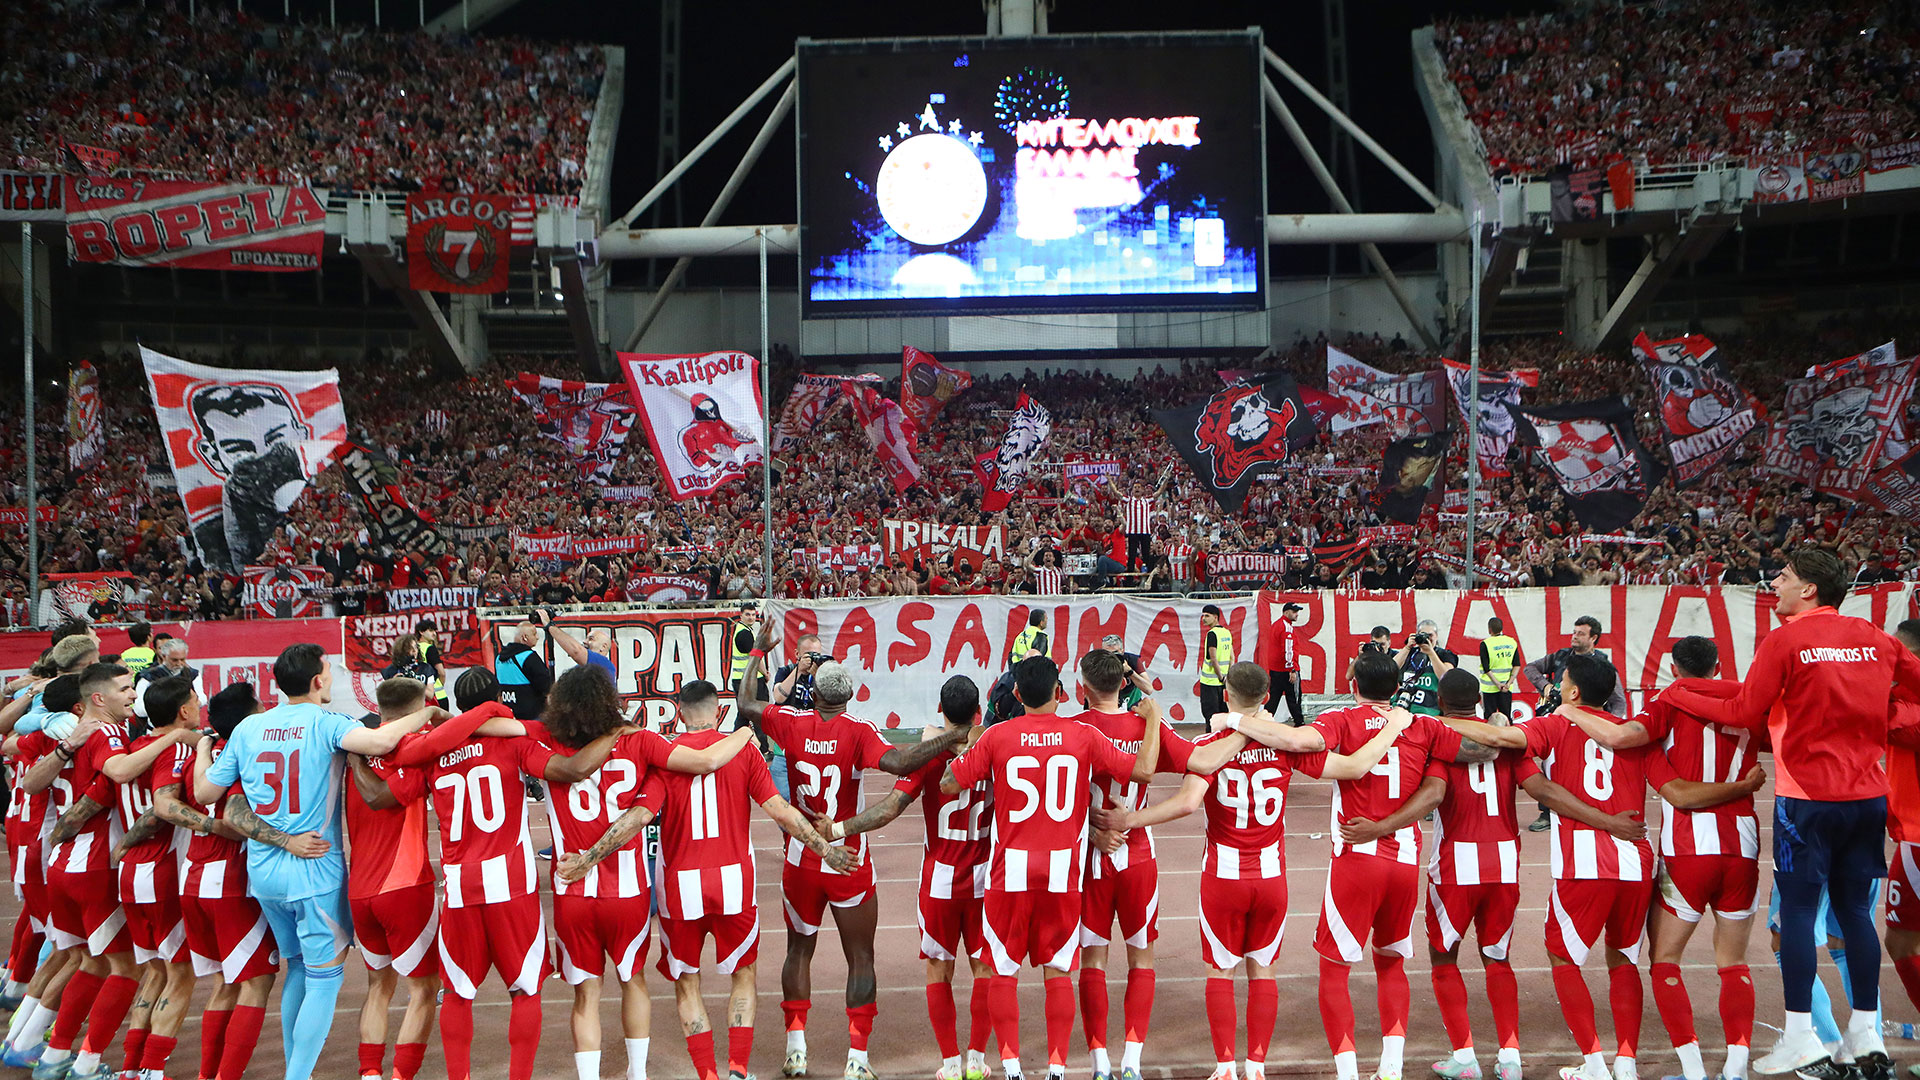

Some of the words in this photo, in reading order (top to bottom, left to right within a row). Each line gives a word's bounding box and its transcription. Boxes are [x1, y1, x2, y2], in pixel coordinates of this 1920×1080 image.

[1, 175, 62, 210] ΙΣΣΑ
[75, 177, 126, 203] Gate
[132, 179, 146, 201] 7
[67, 186, 326, 264] ΒΟΡΕΙΑ
[410, 196, 512, 230] ARGOS
[230, 250, 318, 268] ΠΡΟΑΣΤΕΙΑ
[443, 230, 478, 279] 7
[638, 354, 745, 387] Kallipoli
[48, 510, 56, 521] 7
[575, 538, 636, 554] KALLIPOLI
[639, 537, 646, 548] 7
[883, 518, 1003, 561] TRIKALA
[872, 550, 881, 566] 7
[1207, 553, 1286, 575] SANTORINI
[385, 587, 479, 612] ΜΕΣΟΛΟΓΓΙ
[626, 576, 708, 594] ΔΡΑΠΕΤΣΩΝΑ
[438, 633, 452, 653] 7
[1799, 647, 1862, 665] OLYMPIACOS
[1862, 646, 1878, 662] FC
[1020, 732, 1063, 747] PALMA
[1365, 716, 1389, 731] BIAN
[1583, 737, 1615, 802] 8
[1703, 722, 1751, 784] 17
[255, 748, 301, 816] 31
[795, 761, 842, 824] 23
[1006, 754, 1079, 824] 50
[1217, 767, 1284, 830] 96
[434, 764, 506, 843] 70
[690, 773, 720, 840] 11
[938, 779, 994, 842] 22
